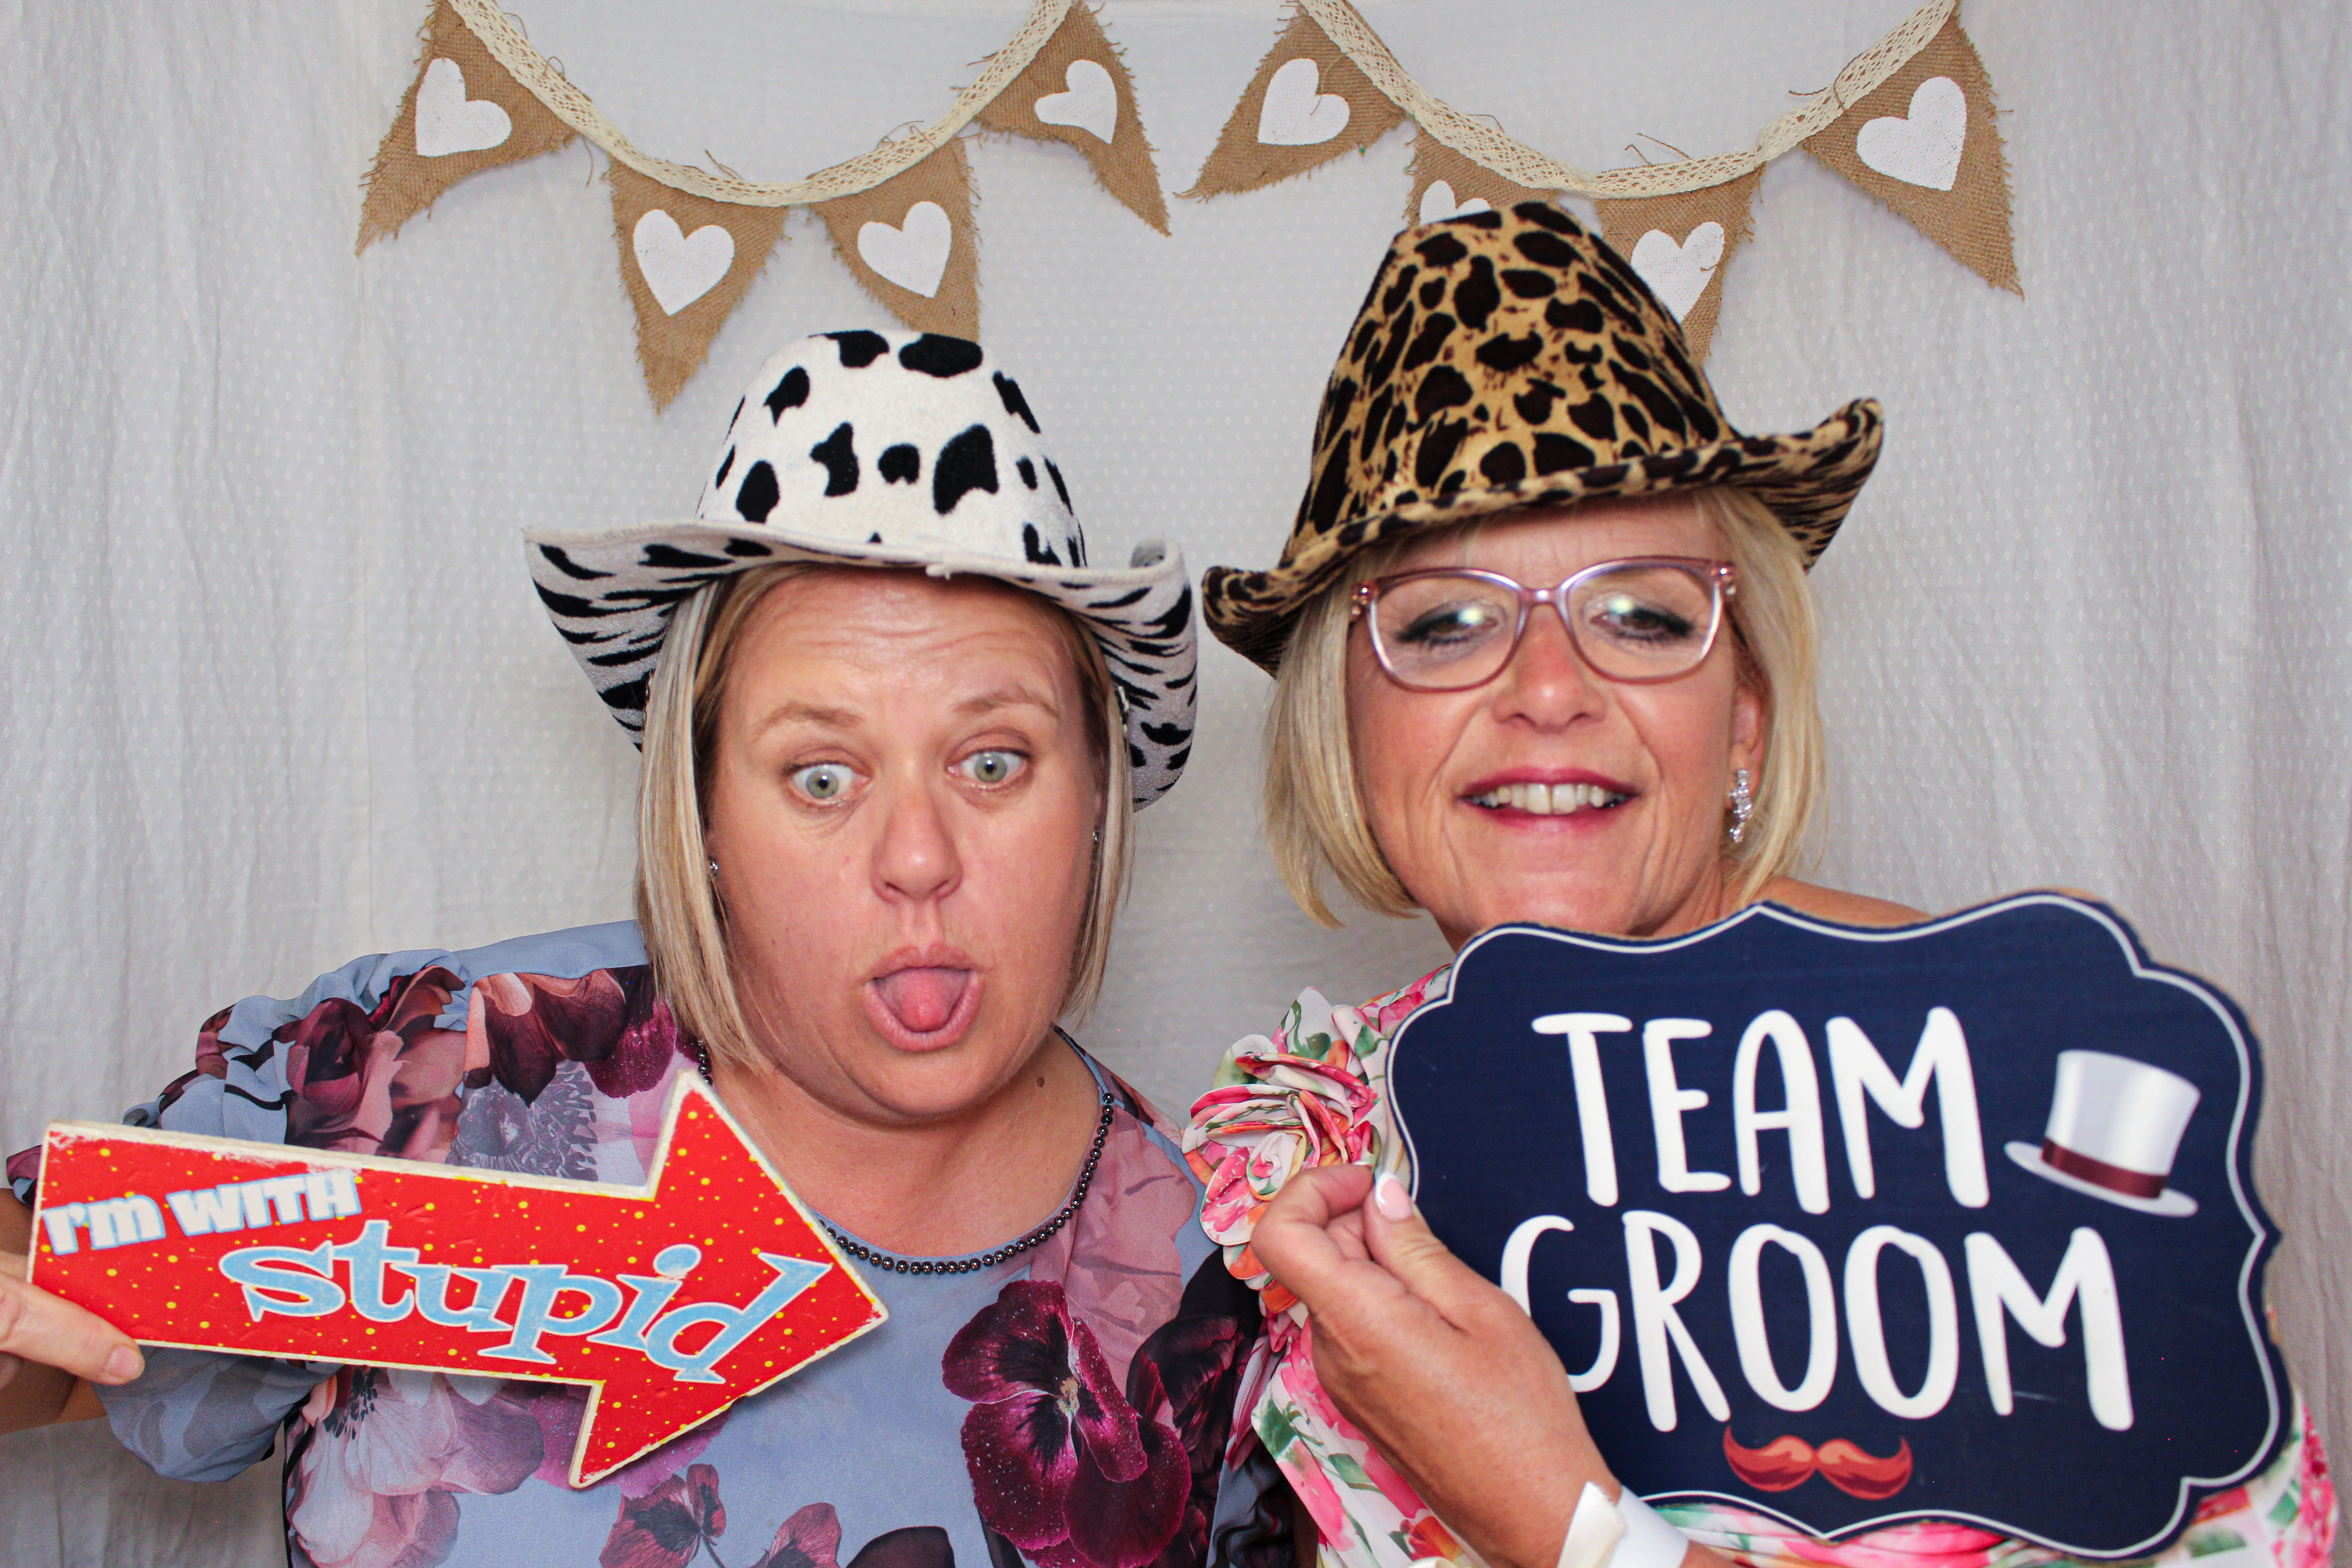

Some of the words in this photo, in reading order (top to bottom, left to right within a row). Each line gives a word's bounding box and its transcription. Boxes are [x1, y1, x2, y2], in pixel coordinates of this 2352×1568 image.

[165, 1169, 362, 1236] WITH
[1532, 1006, 1990, 1214] TEAM
[1500, 1210, 2134, 1432] GROOM
